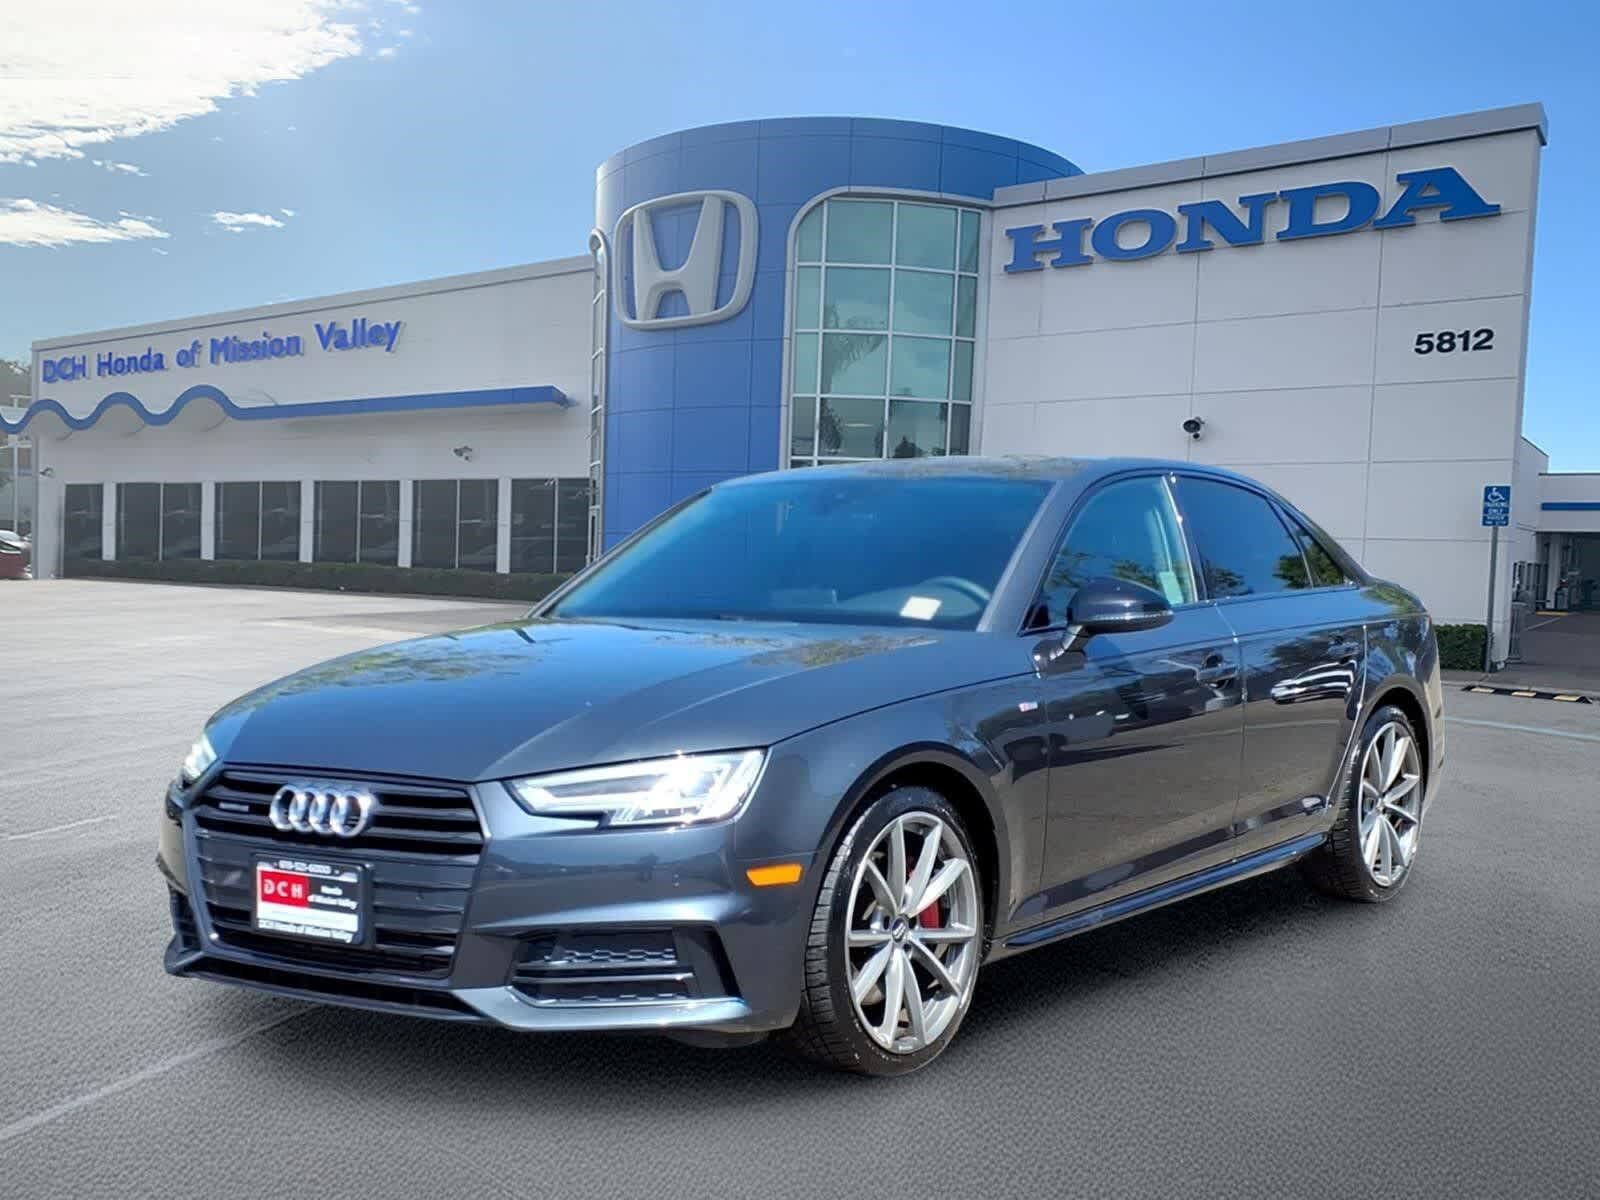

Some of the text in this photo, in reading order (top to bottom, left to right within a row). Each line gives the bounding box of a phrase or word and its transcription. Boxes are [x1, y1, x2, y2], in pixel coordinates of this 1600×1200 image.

[1004, 166, 1501, 273] HONDA
[42, 317, 402, 382] DCH Honda of Mission Valley
[1413, 328, 1494, 355] 5812
[263, 878, 303, 899] DCH
